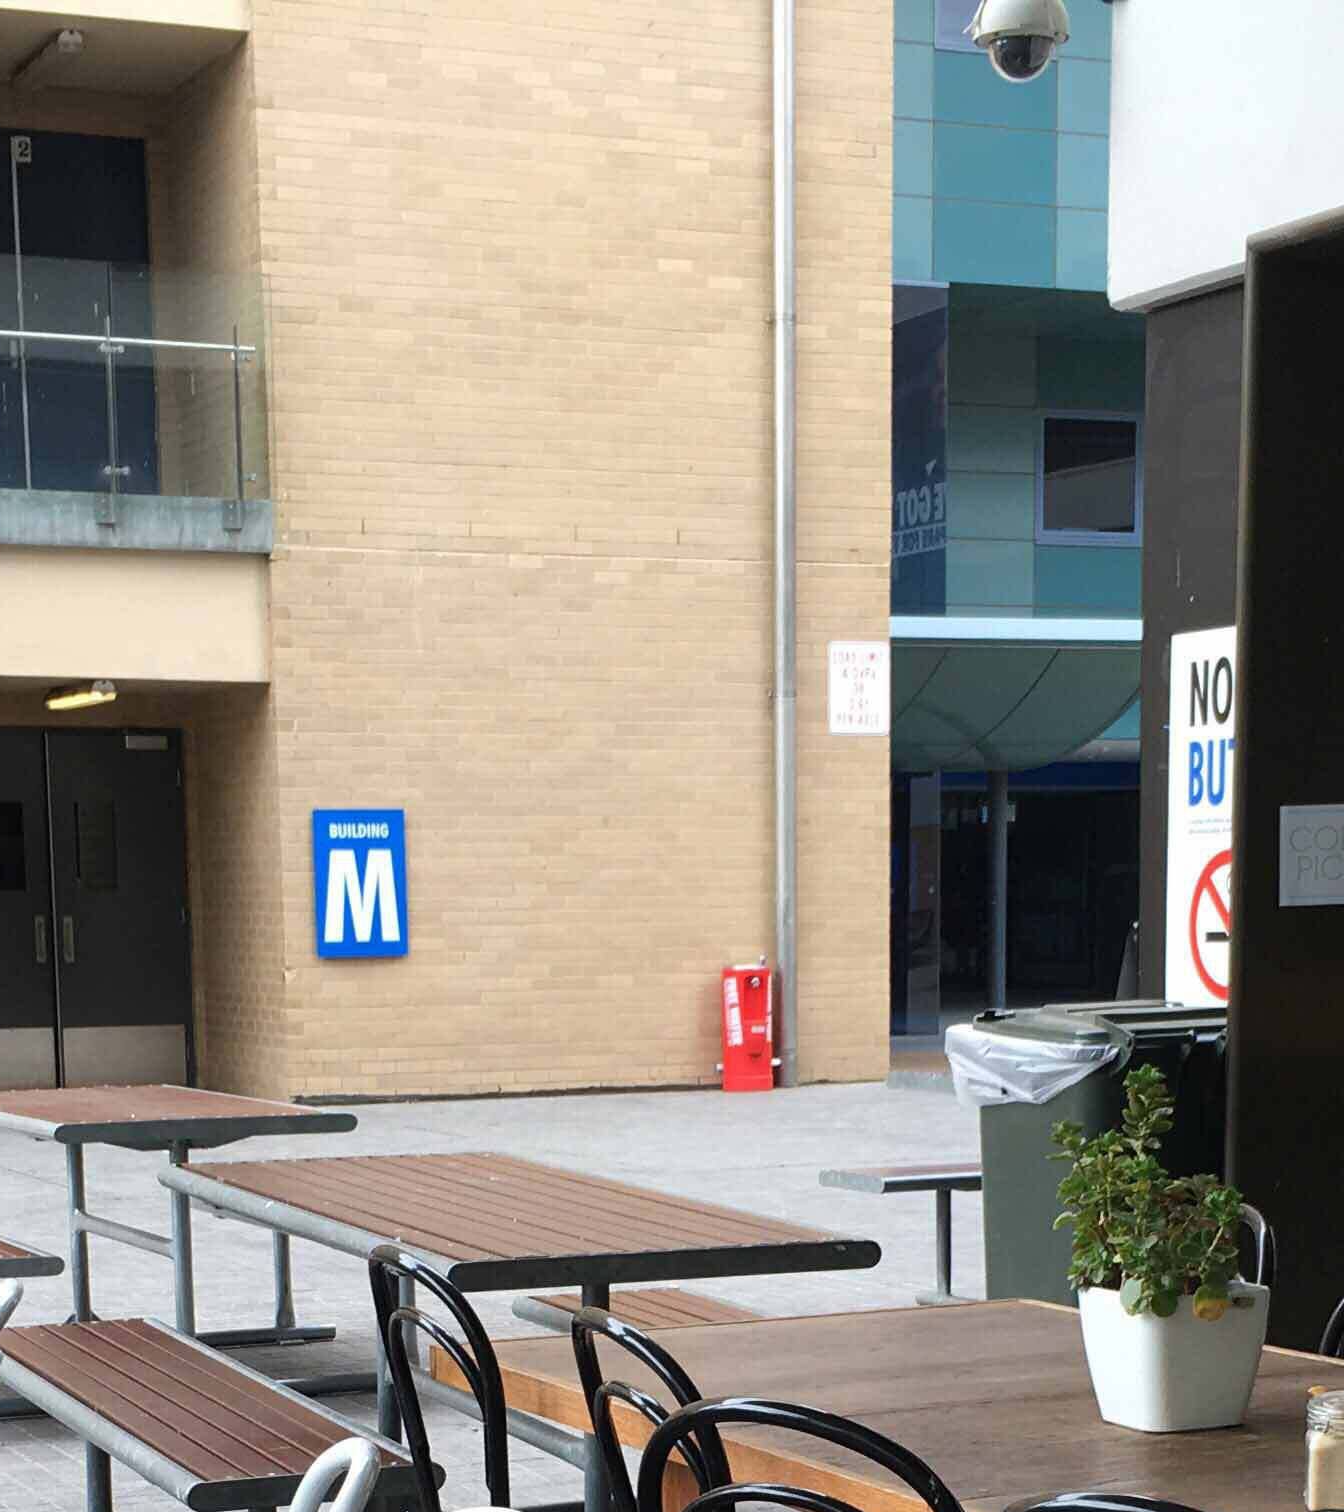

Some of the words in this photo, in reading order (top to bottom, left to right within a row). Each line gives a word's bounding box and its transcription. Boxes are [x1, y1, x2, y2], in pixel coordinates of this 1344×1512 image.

[18, 140, 29, 157] 2
[1190, 656, 1233, 726] NO
[329, 823, 389, 839] BUILDING
[324, 849, 400, 943] M
